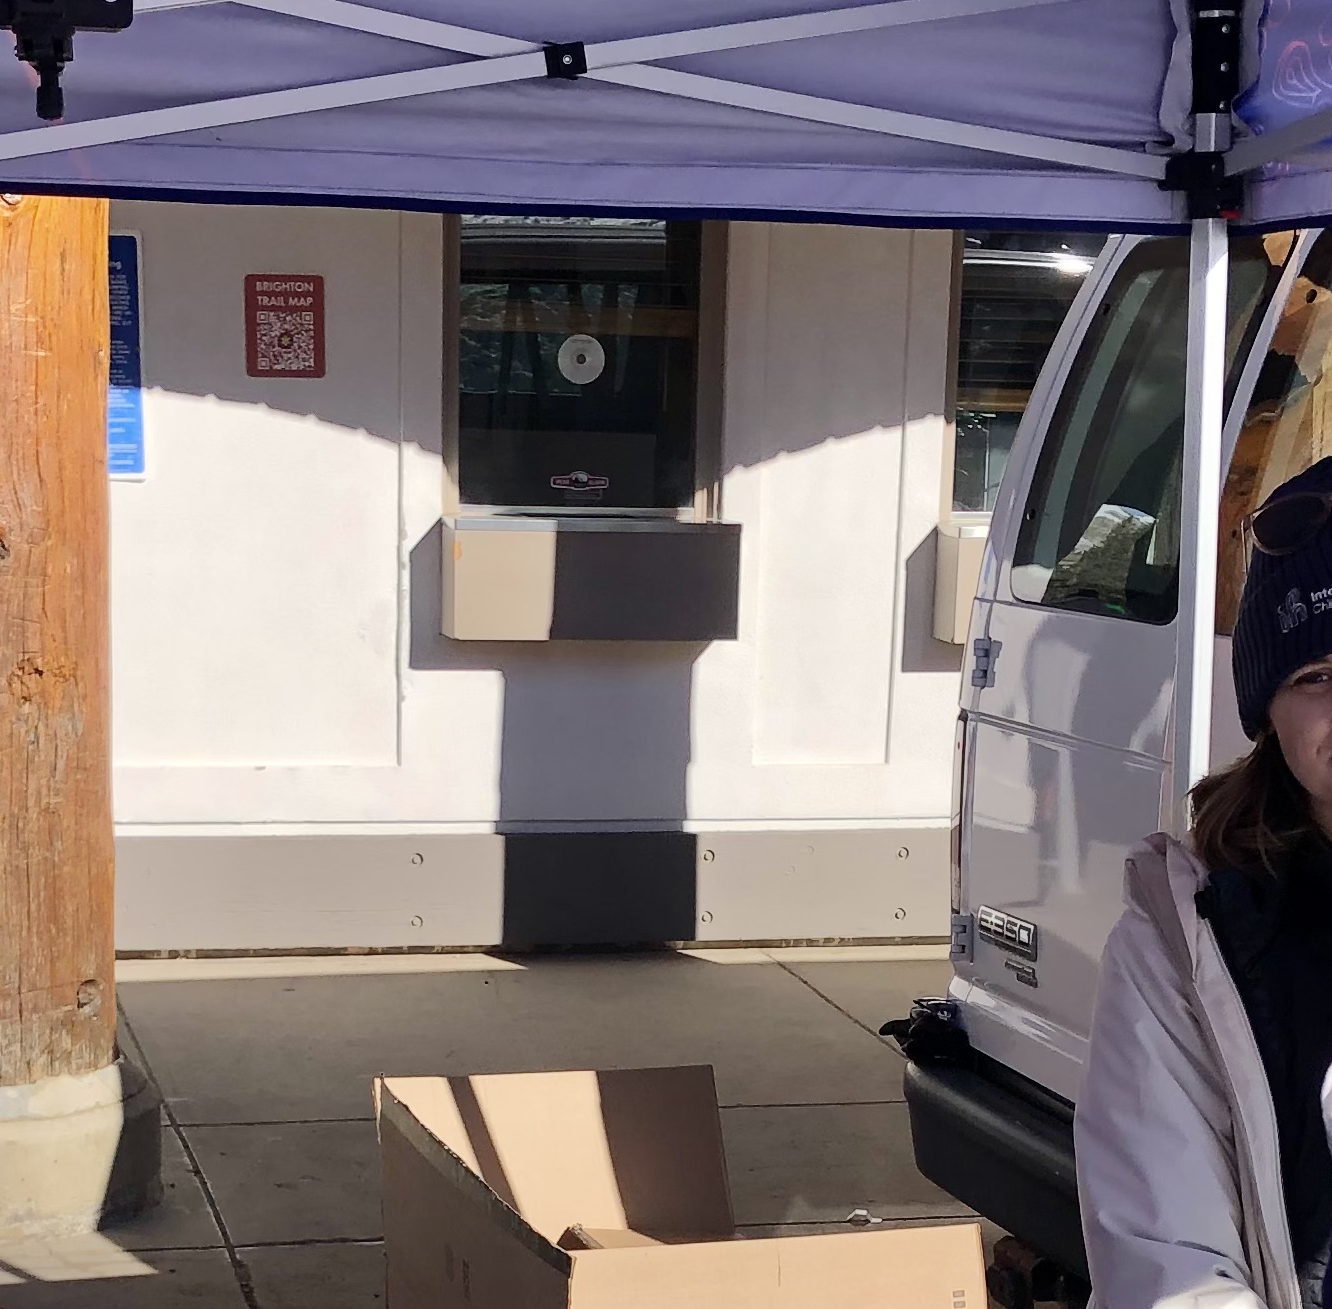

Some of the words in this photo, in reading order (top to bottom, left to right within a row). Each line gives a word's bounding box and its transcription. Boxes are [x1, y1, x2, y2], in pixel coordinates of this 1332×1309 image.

[255, 281, 314, 292] BRIGHTON
[256, 296, 285, 306] TRAIL
[289, 296, 314, 306] MAP
